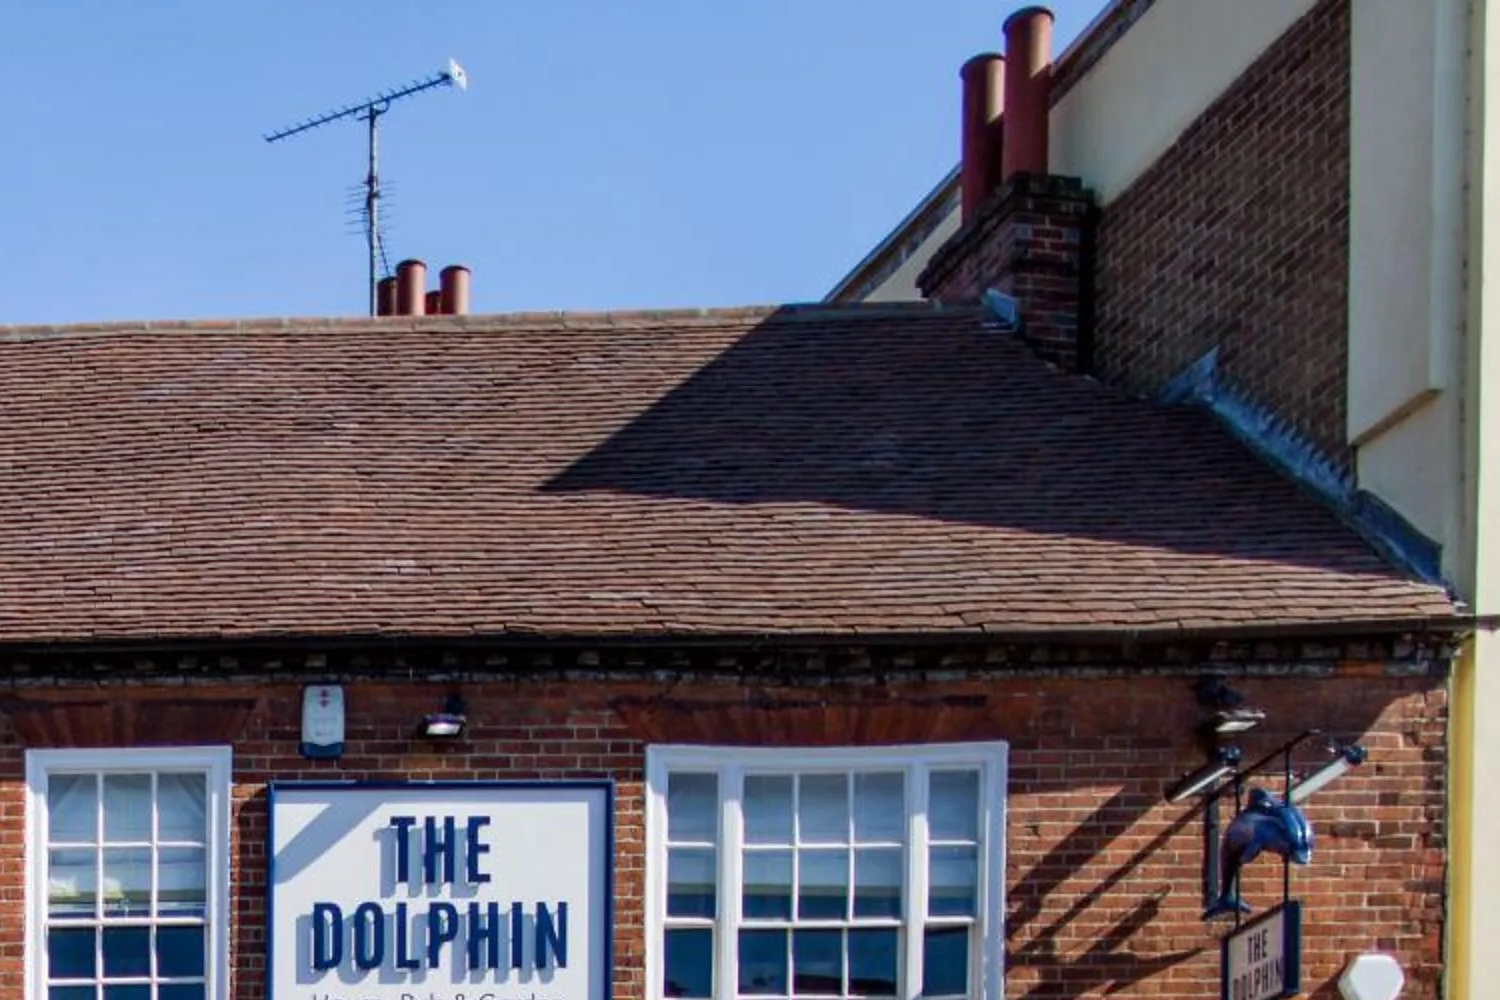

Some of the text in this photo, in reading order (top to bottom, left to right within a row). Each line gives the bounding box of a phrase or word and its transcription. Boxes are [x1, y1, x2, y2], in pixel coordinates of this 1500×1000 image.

[390, 815, 491, 883] THE
[313, 901, 568, 970] DOLPHIN
[1247, 928, 1268, 964] THE
